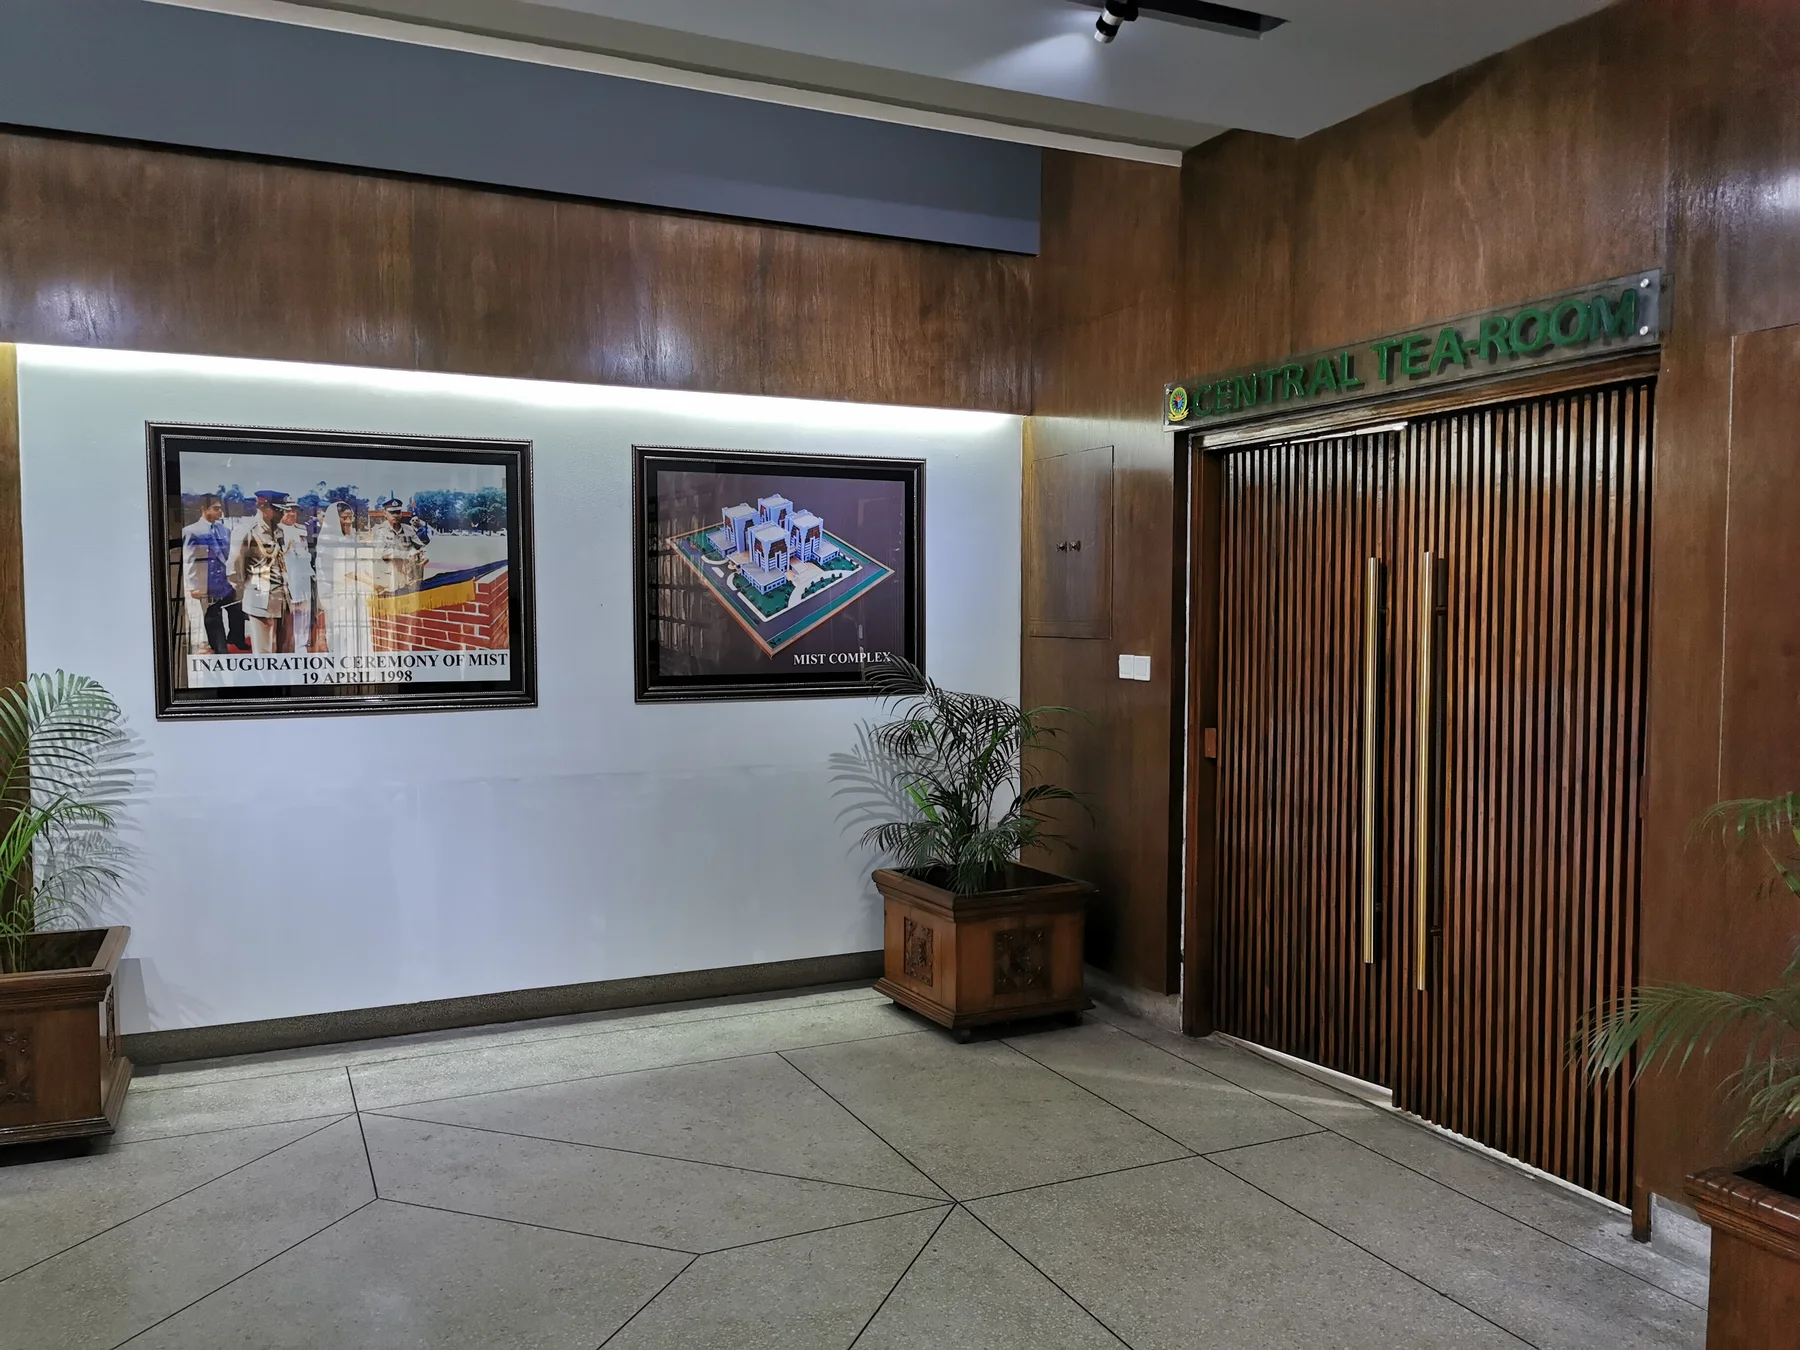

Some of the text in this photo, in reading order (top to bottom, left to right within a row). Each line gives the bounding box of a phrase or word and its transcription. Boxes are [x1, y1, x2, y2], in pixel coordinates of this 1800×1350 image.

[1192, 287, 1637, 417] CENTRAL TEA-ROOM
[191, 653, 508, 672] INAUGURATION CEREMONY OF MIST
[793, 651, 891, 666] MIST COMPLEX
[303, 669, 413, 684] 19 APRIL 1998
